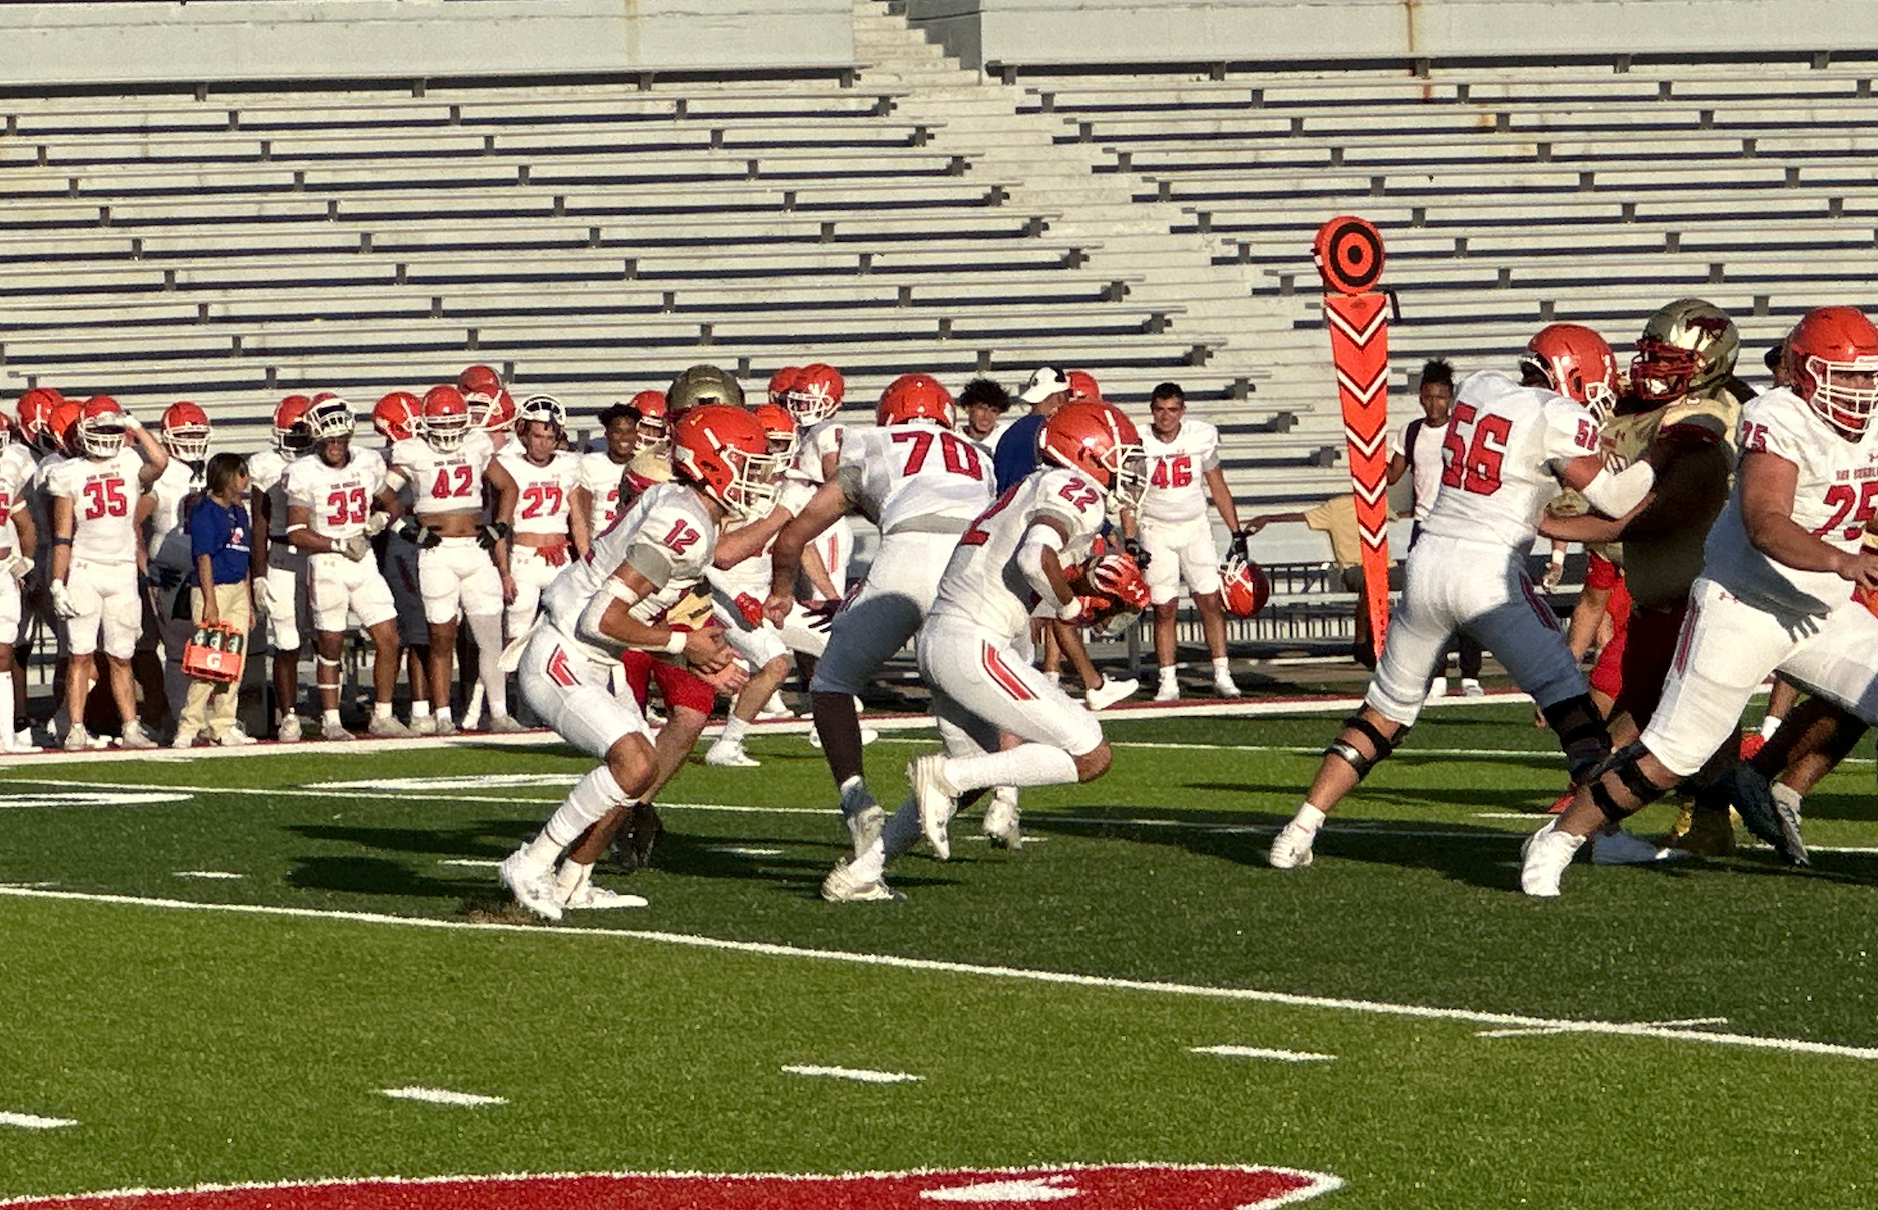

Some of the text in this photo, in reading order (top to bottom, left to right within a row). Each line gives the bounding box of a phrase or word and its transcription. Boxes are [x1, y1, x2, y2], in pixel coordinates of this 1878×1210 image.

[1441, 400, 1513, 496] 56
[1740, 420, 1768, 453] 75
[891, 430, 983, 481] 70
[1151, 456, 1192, 489] 46
[83, 479, 127, 520] 35
[431, 465, 472, 499] 42
[1058, 477, 1099, 514] 22
[327, 487, 368, 526] 33
[522, 486, 563, 520] 27
[663, 519, 701, 555] 12
[207, 653, 221, 669] G
